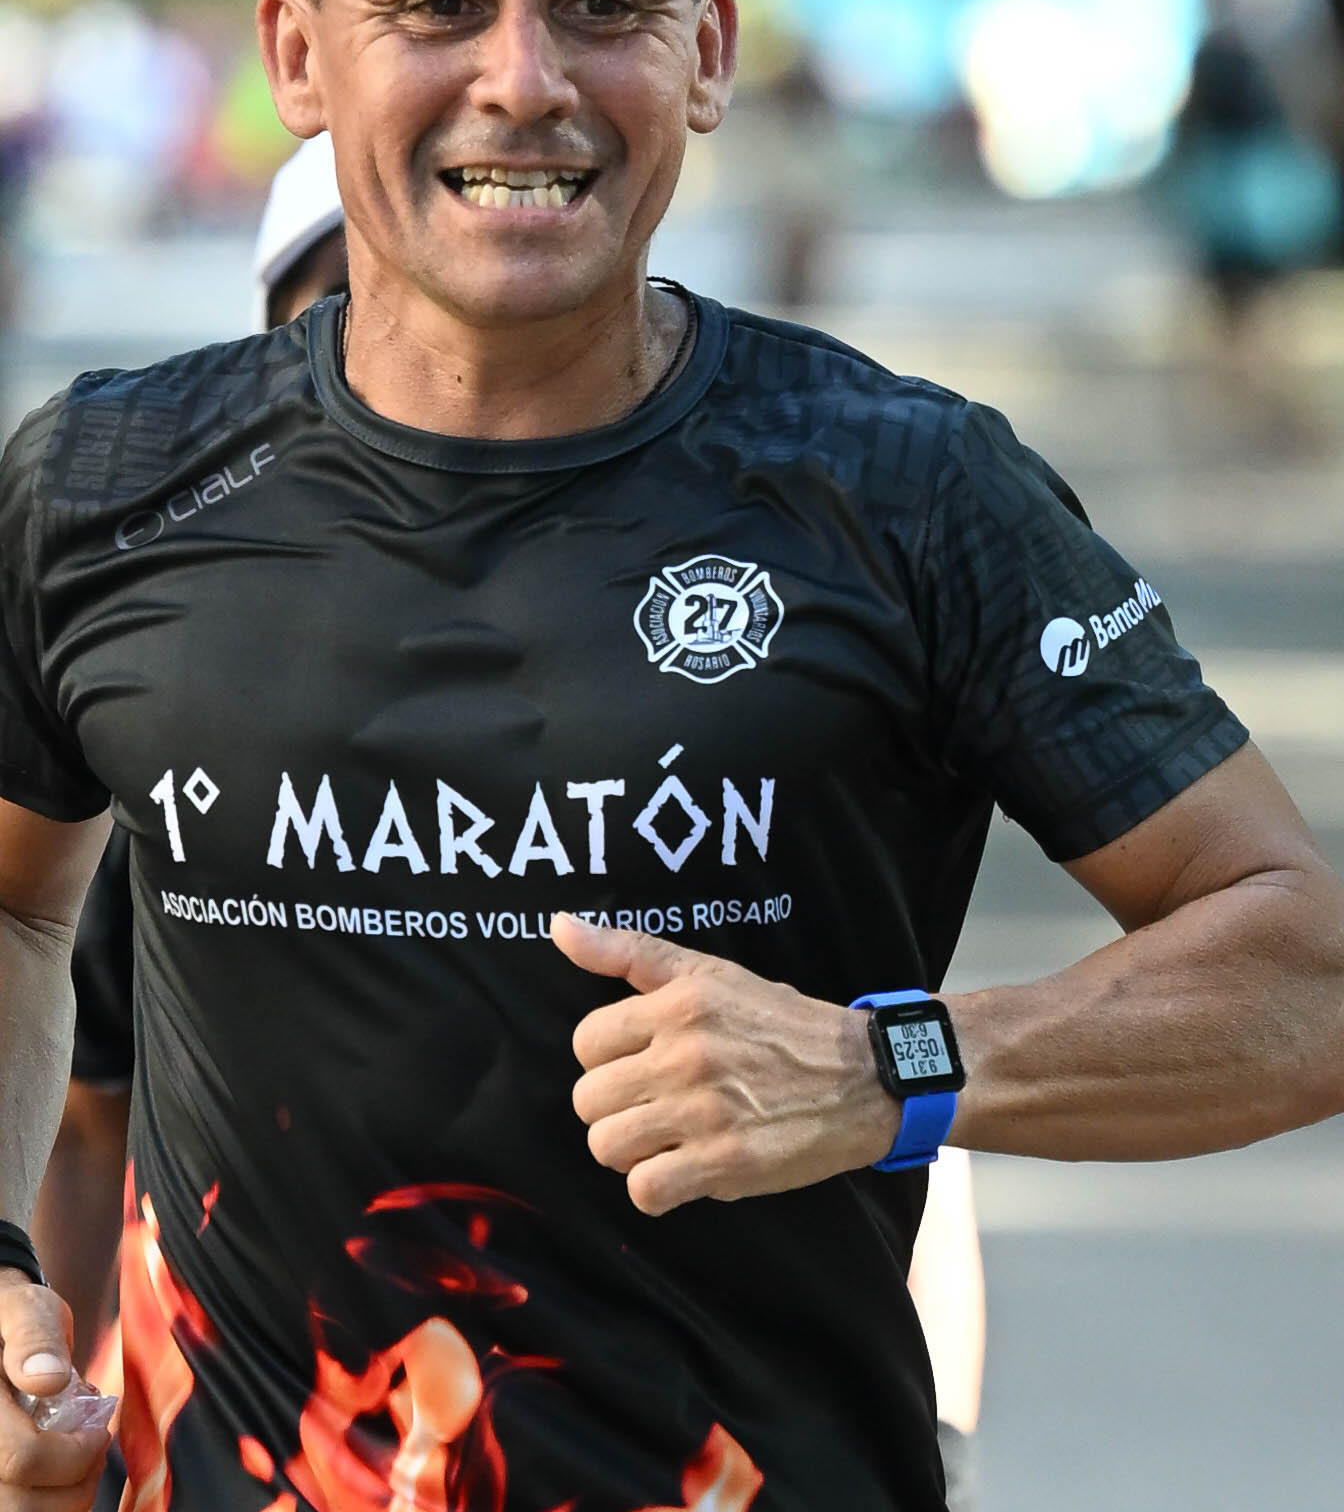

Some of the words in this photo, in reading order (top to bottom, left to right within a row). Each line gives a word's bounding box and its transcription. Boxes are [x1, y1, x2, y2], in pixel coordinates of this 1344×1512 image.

[680, 566, 738, 585] BOMBEROS
[684, 594, 738, 636] 27
[683, 653, 730, 671] ROSARIO
[266, 743, 776, 879] MARATÓN
[160, 890, 288, 928] ASOCIACIÓN
[294, 903, 470, 939] BOMBEROS
[475, 906, 684, 939] VOLUTARIOS
[692, 894, 792, 931] ROSARIO
